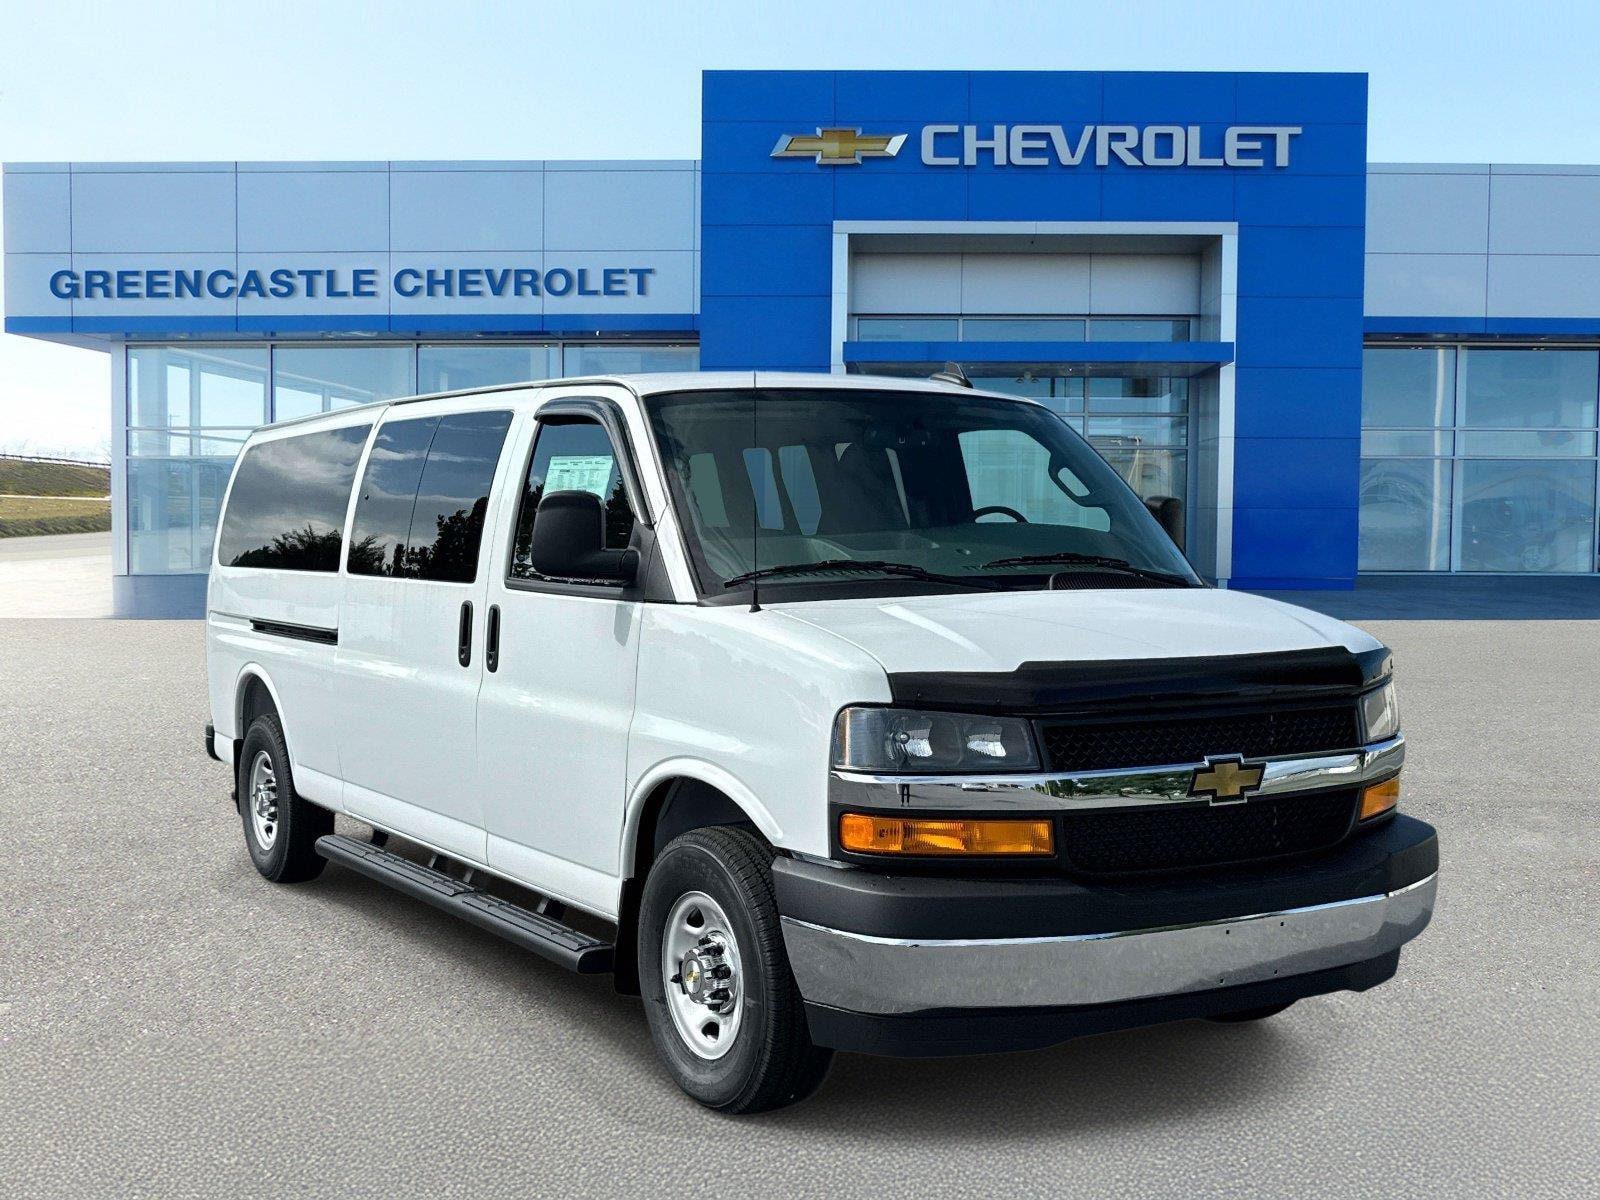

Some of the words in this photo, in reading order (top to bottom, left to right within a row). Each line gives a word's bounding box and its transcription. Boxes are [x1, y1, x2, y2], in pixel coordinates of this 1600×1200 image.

[921, 124, 1302, 167] CHEVROLET
[50, 269, 377, 299] GREENCASTLE
[393, 268, 654, 297] CHEVROLET
